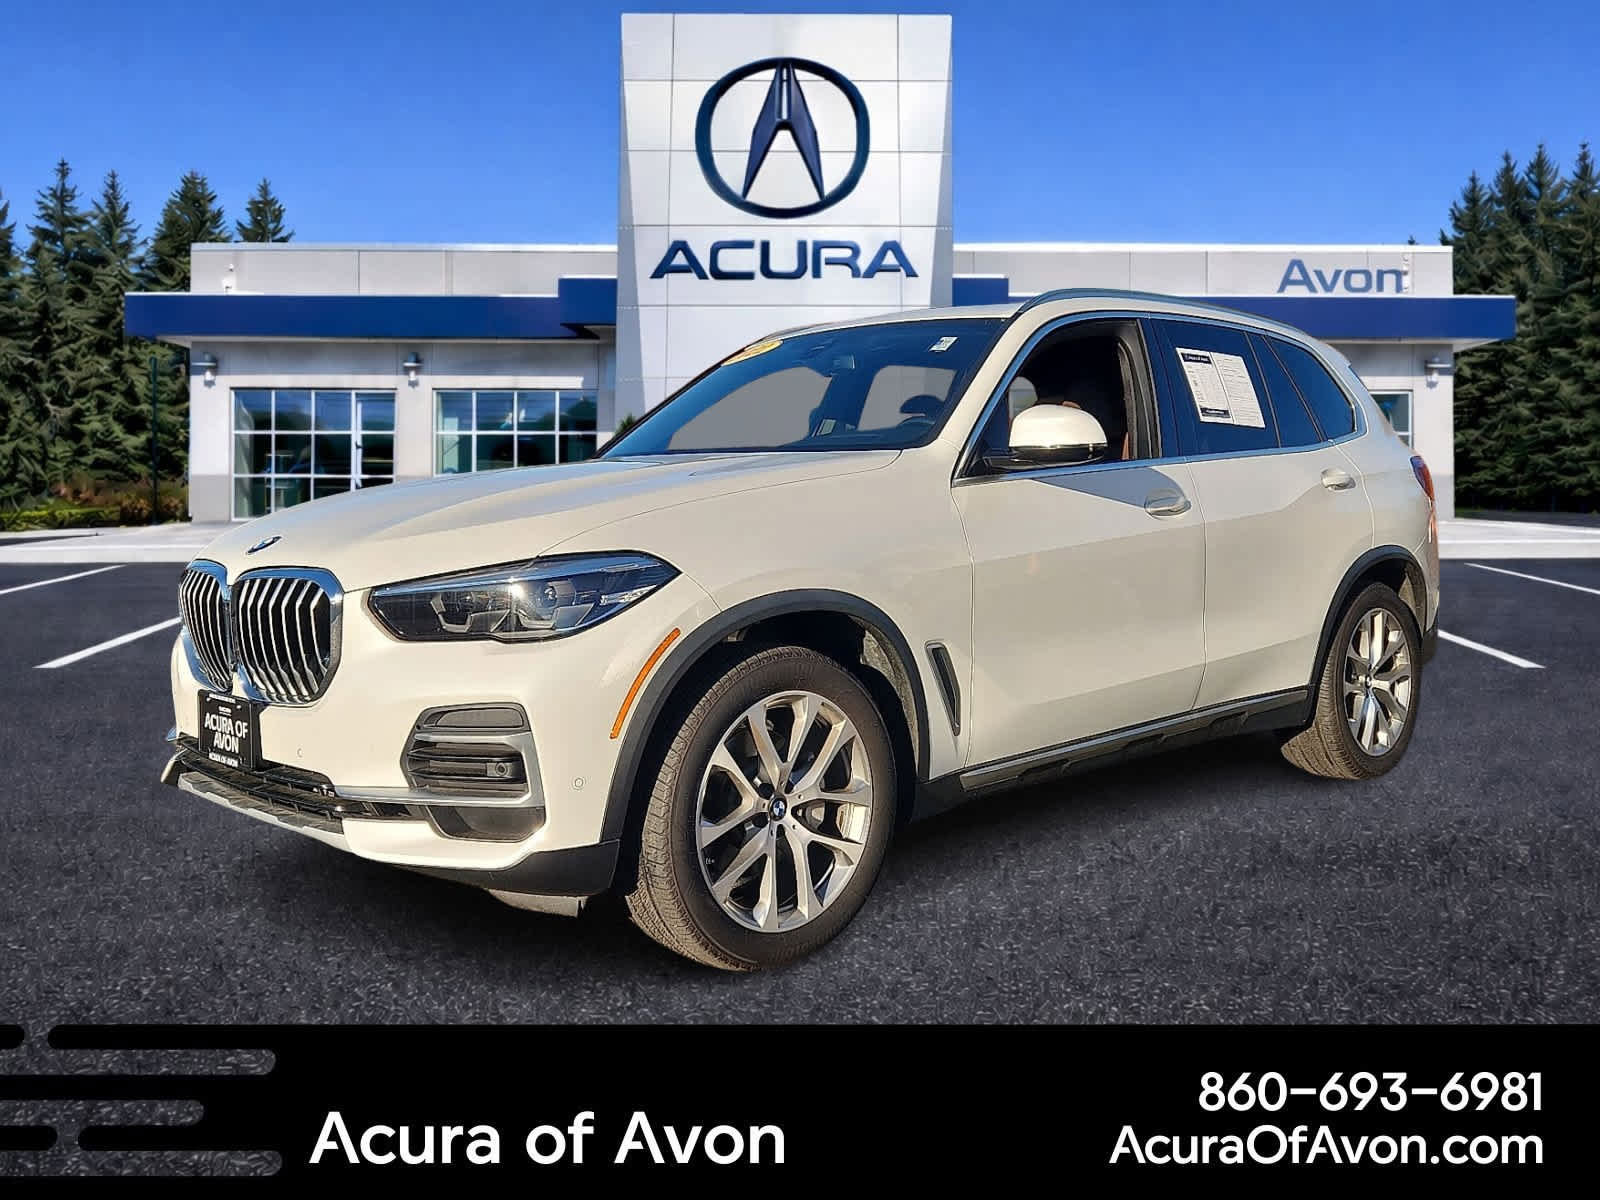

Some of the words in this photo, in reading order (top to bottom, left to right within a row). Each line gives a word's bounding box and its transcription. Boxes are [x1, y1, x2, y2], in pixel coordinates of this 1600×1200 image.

[650, 240, 918, 280] ACURA
[1277, 258, 1403, 293] Avon
[204, 712, 234, 735] ACURA
[235, 720, 248, 739] OF
[213, 731, 239, 754] AVON
